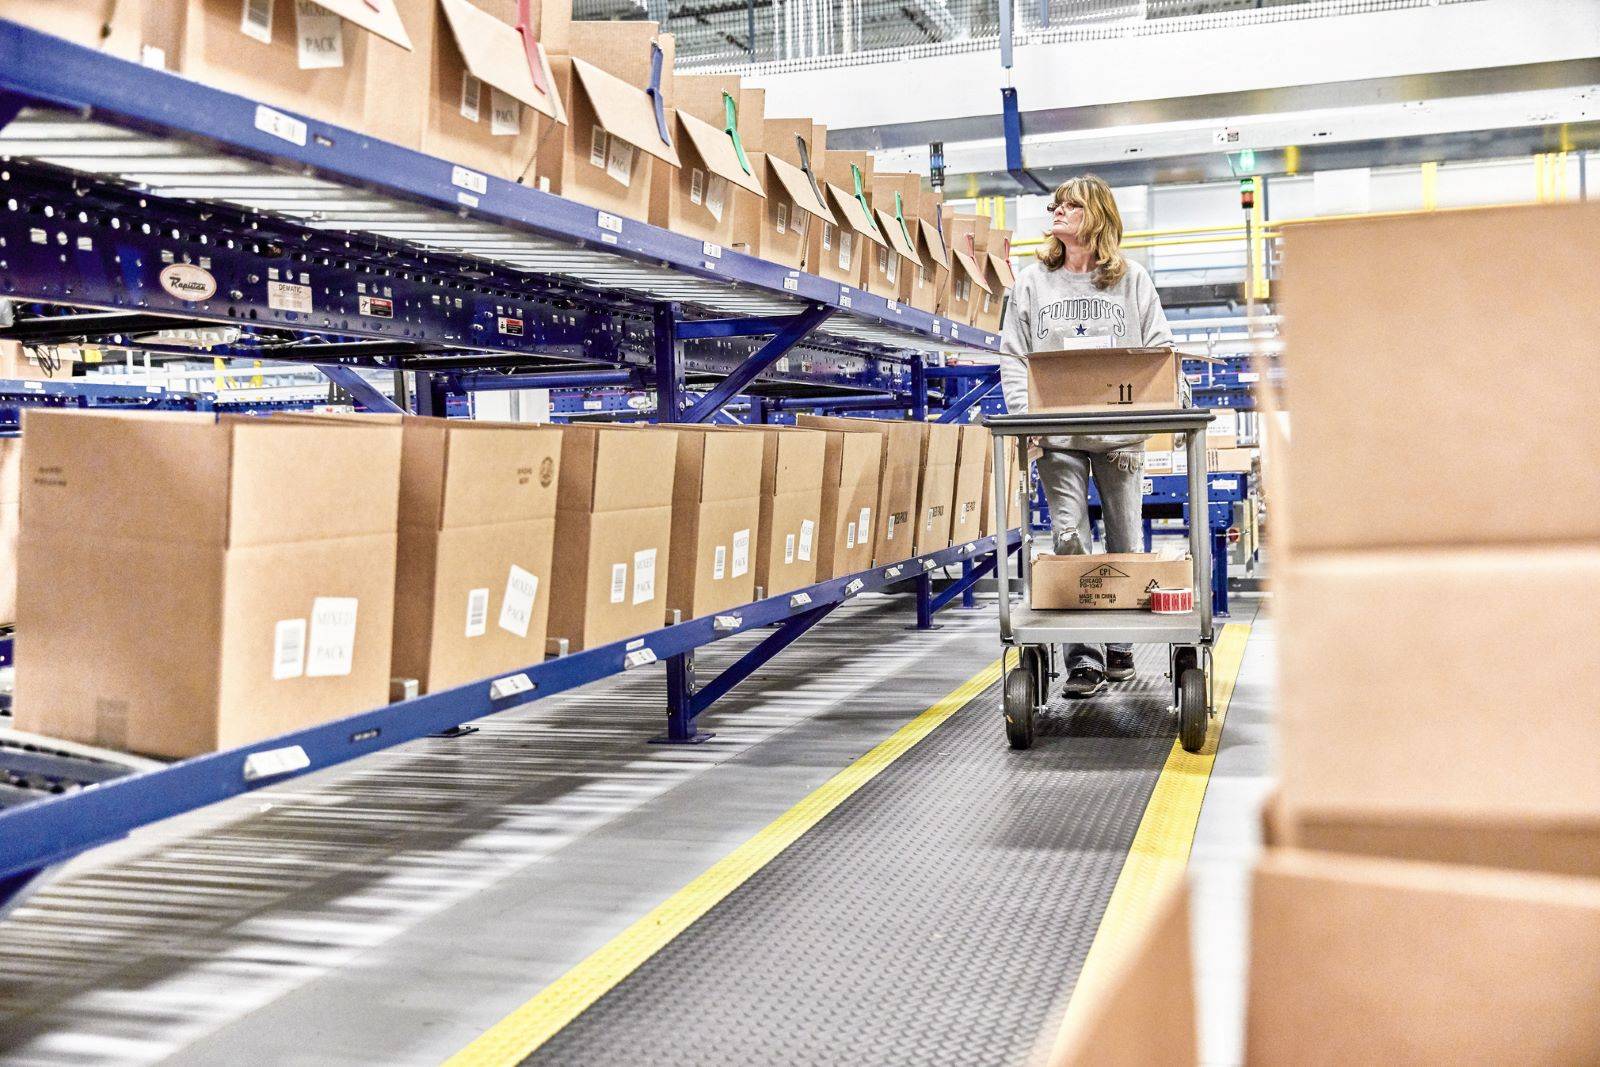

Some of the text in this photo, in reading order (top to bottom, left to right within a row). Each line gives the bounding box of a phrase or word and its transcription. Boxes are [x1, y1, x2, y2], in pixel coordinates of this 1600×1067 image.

[305, 36, 337, 53] PACK
[278, 284, 302, 294] DEMATIC
[1037, 298, 1125, 340] COWBOYS
[1100, 568, 1111, 576] CPI
[511, 575, 535, 597] MIXED
[317, 610, 353, 626] MIXED
[506, 604, 526, 623] PACK
[316, 645, 345, 660] PACK
